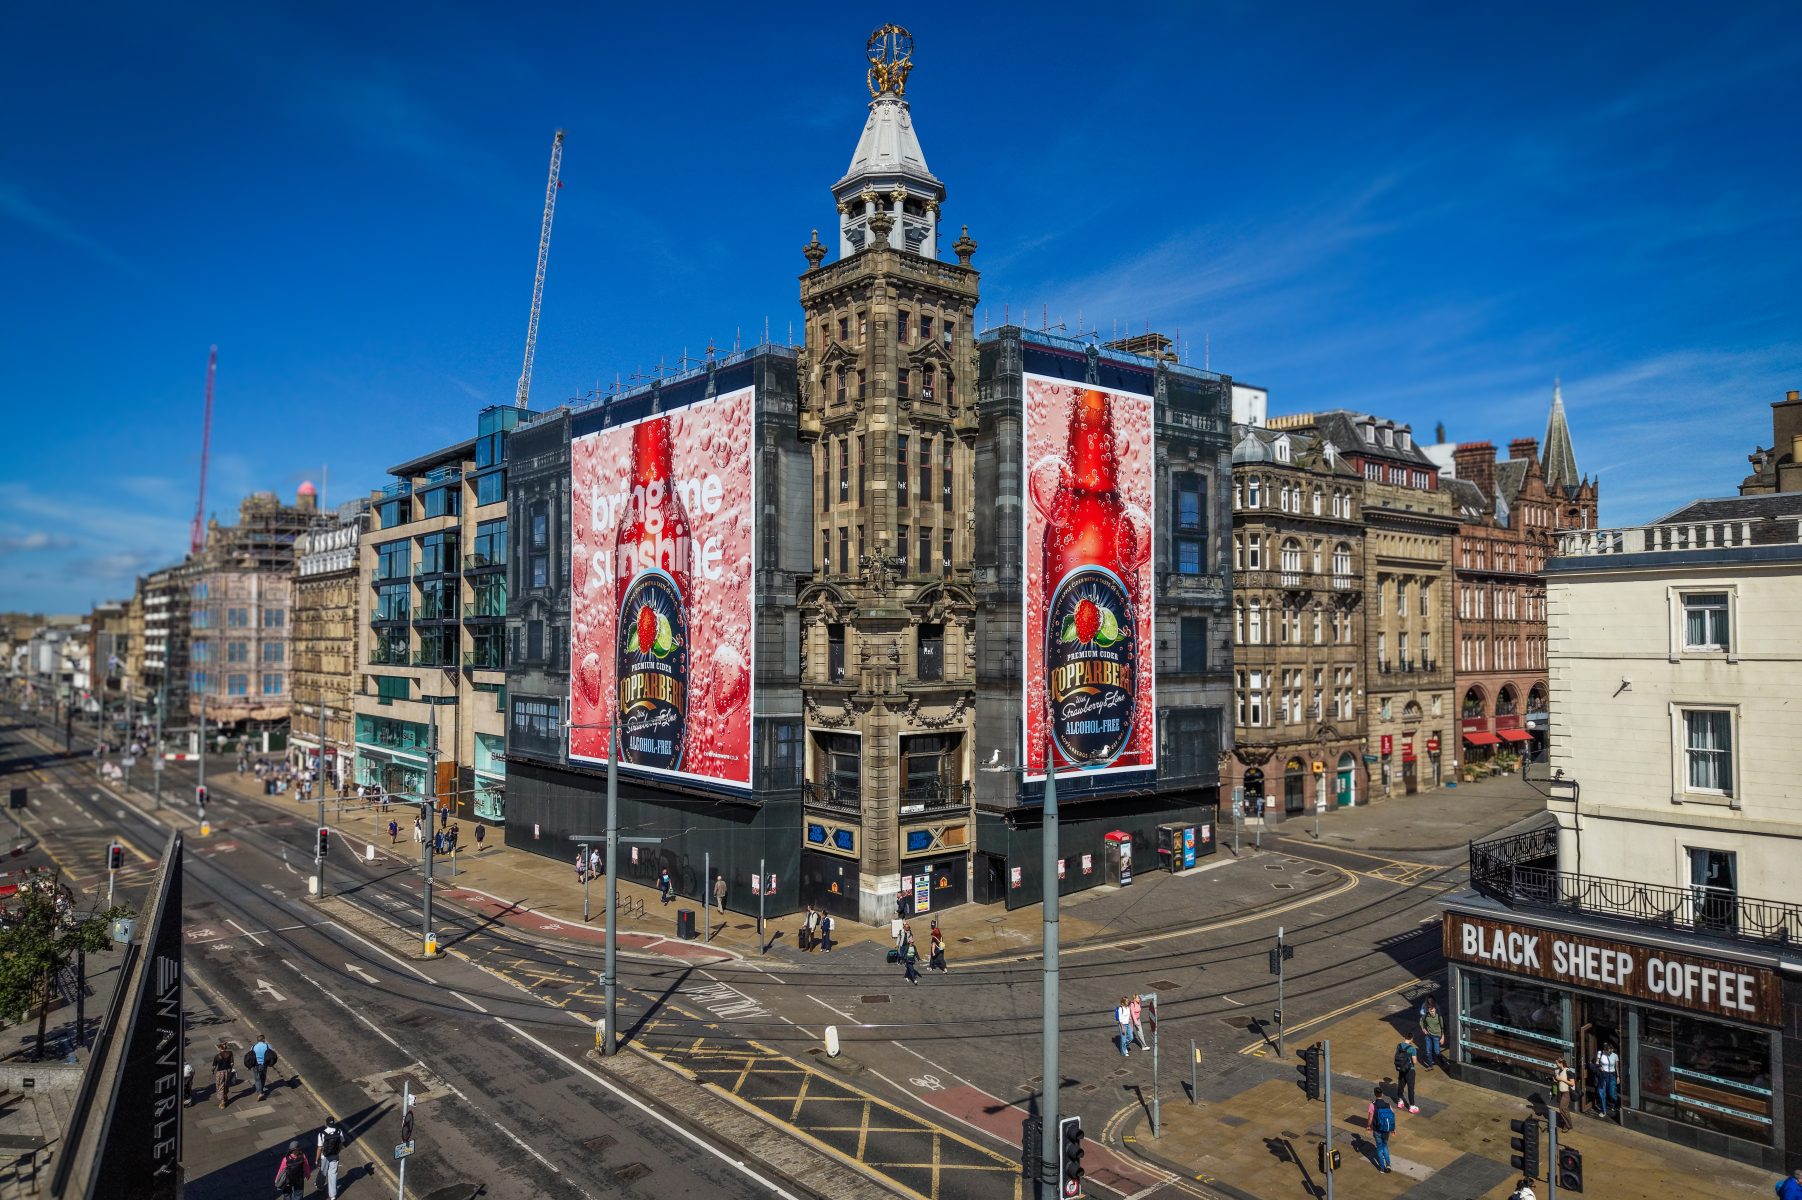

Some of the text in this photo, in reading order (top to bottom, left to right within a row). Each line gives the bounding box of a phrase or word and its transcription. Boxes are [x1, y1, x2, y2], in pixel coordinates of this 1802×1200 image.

[592, 474, 723, 534] bring me
[592, 524, 723, 587] sunshine
[631, 661, 672, 674] PREMIUM CIDER
[1067, 651, 1119, 662] PREMIUM CIDER
[620, 672, 684, 716] KOPPARBERG
[1051, 660, 1133, 703] KOPPARBERG
[629, 736, 672, 755] ALCOHOL-FREE
[1065, 718, 1120, 735] ALCOHOL-FREE
[1462, 922, 1756, 1013] BLACK SHEEP COFFEE
[707, 1000, 772, 1020] ONLY
[153, 985, 178, 1177] WAVERLEY
